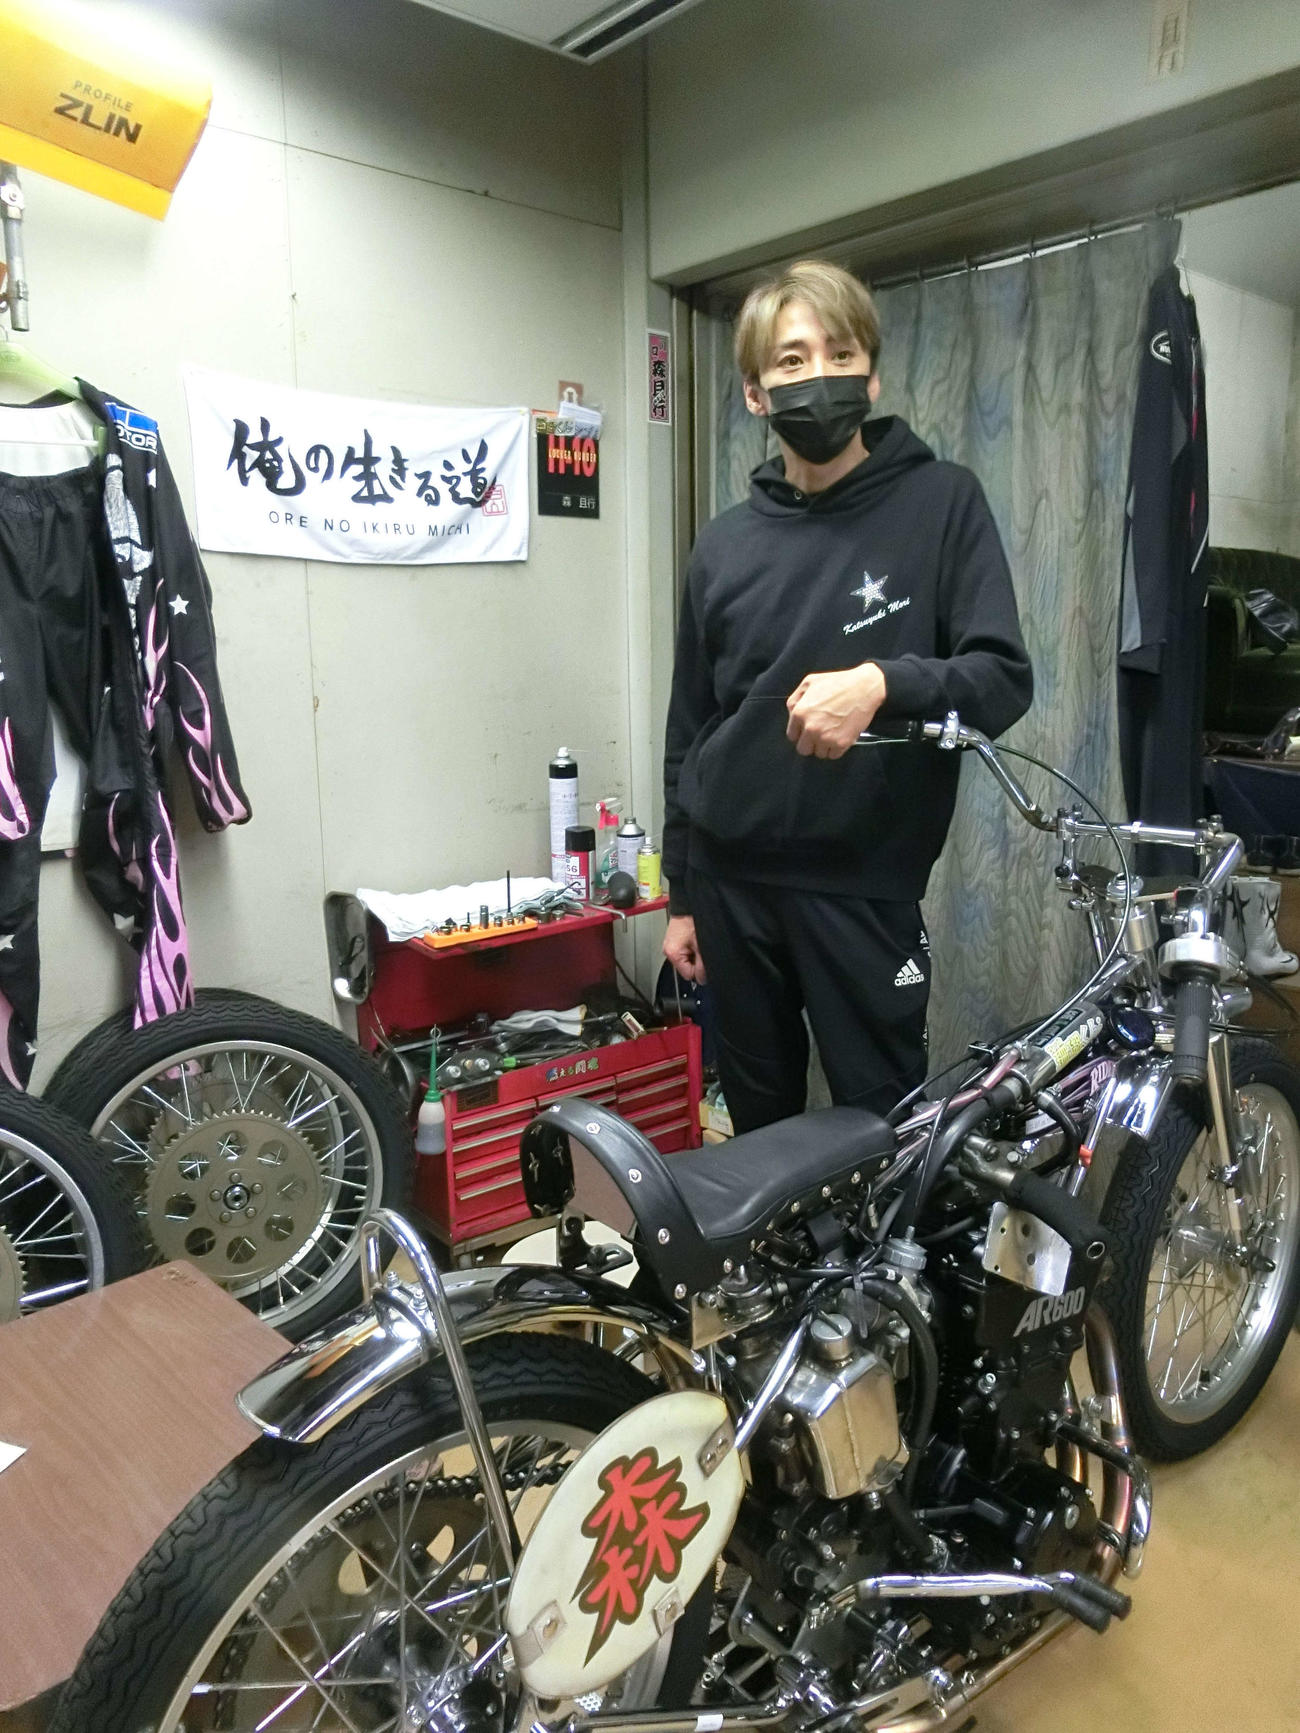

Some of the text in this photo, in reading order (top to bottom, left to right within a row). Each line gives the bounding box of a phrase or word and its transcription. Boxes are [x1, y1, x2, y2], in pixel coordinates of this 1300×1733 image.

[73, 80, 134, 112] PROFILE
[54, 92, 143, 145] ZLIN
[227, 416, 497, 508] 俺の生きる道
[269, 511, 471, 538] ORE NO IKIRU MICHI
[843, 596, 911, 636] Katsuyuki Mori
[894, 973, 925, 988] adidas
[1012, 1286, 1087, 1338] AR600
